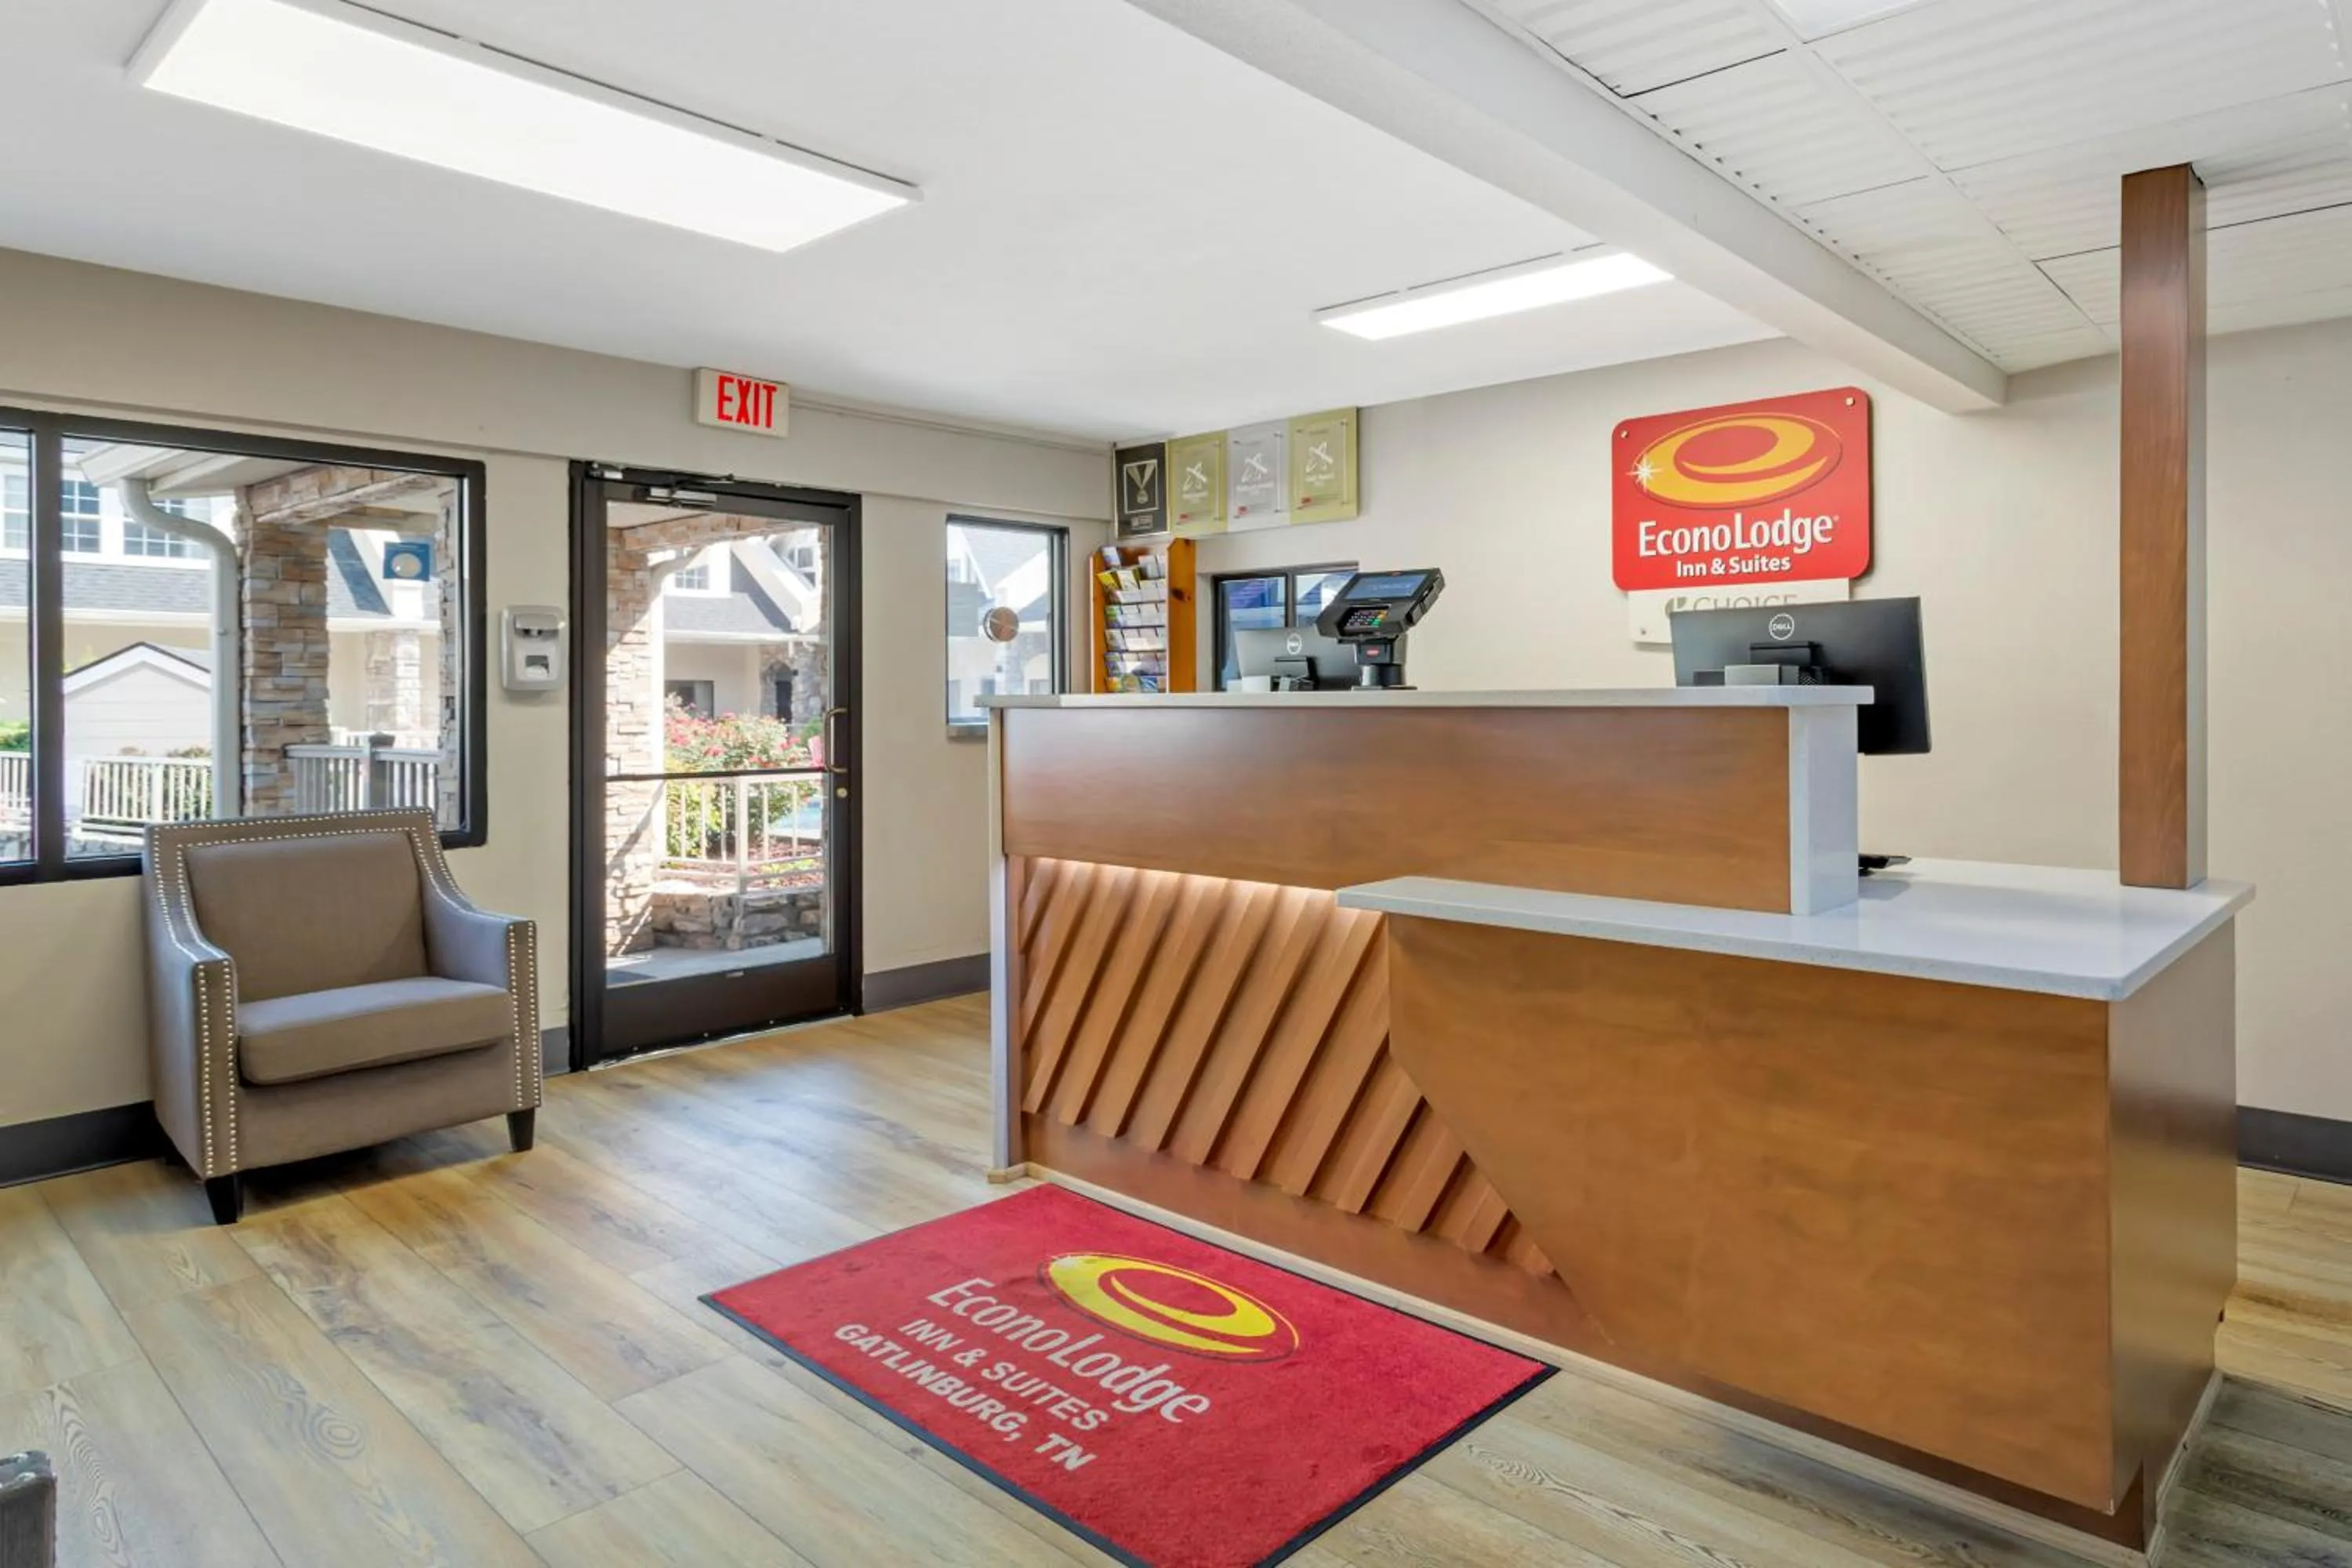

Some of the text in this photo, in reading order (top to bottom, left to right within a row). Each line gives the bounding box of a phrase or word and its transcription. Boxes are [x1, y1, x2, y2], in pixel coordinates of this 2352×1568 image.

[717, 375, 777, 428] EXIT
[1639, 508, 1834, 557] EconoLodge
[1676, 554, 1791, 578] Inn & Suites
[898, 1318, 1109, 1431] INN & SUITES
[927, 1276, 1212, 1424] EconoLodge
[833, 1323, 1097, 1471] GATLINBURG, TN
